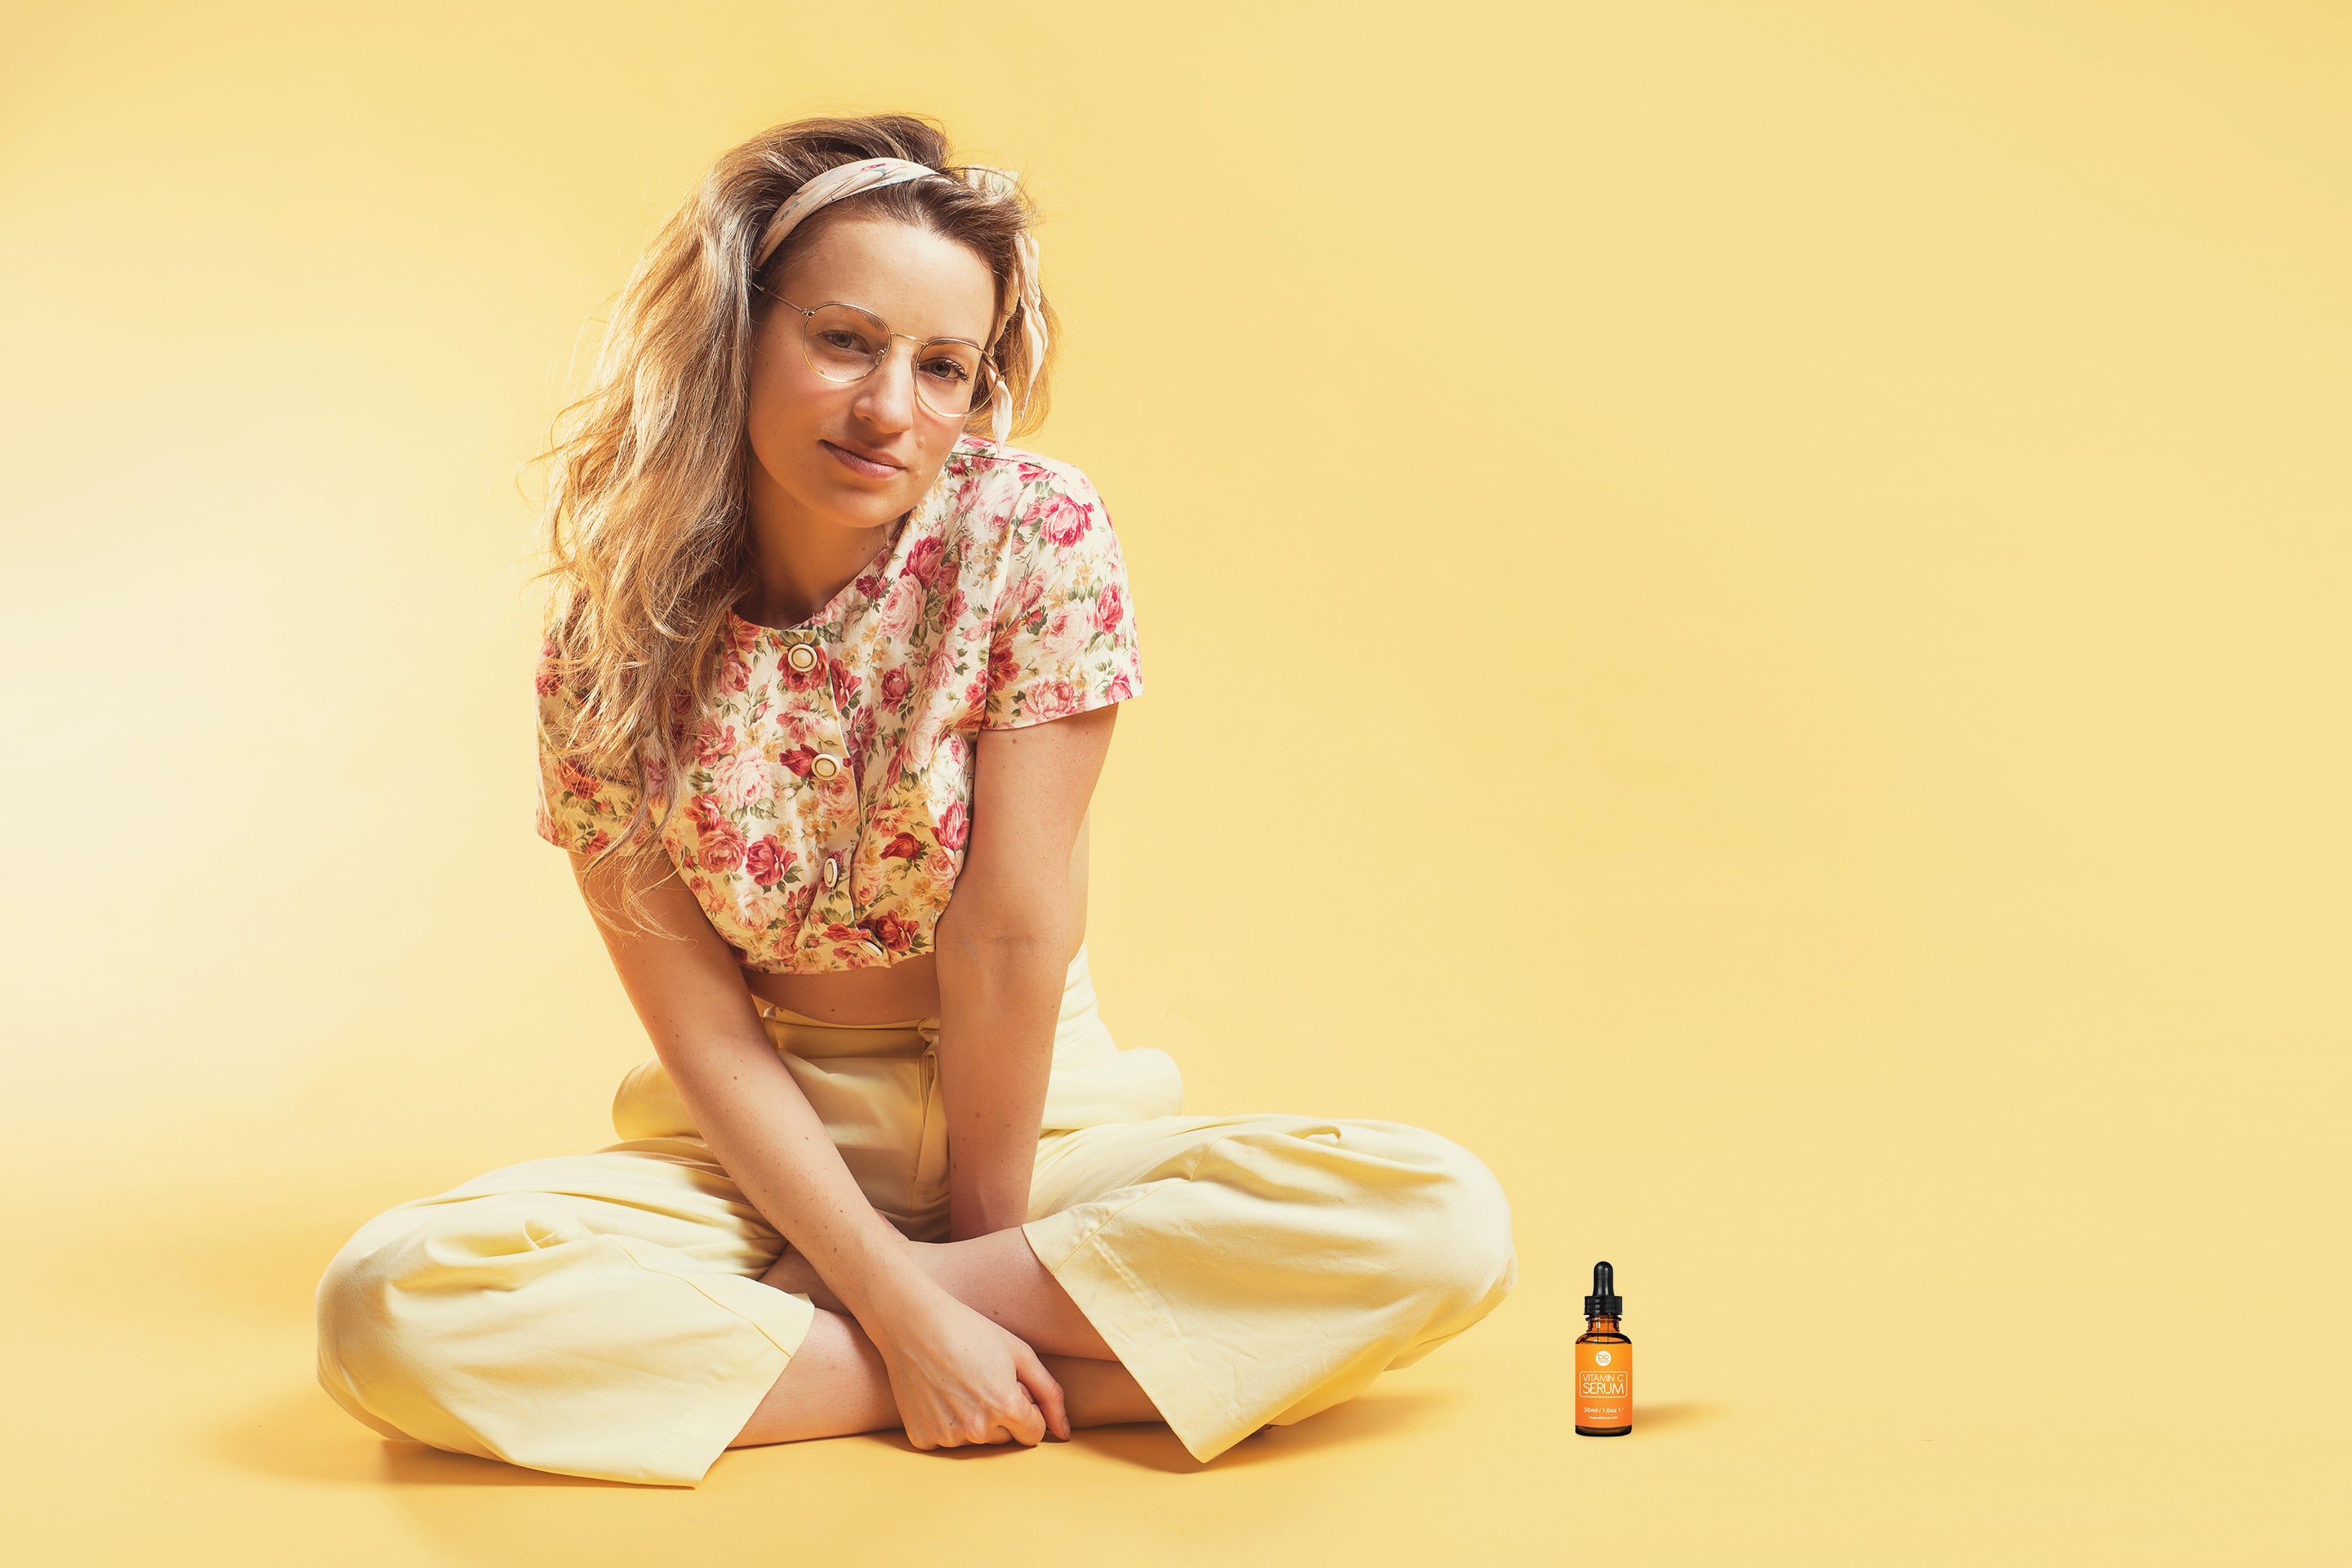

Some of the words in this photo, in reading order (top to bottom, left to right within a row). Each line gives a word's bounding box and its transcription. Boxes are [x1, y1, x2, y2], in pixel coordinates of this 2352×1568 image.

[1582, 1374, 1615, 1382] VITAMIN
[1617, 1374, 1624, 1382] C
[1582, 1382, 1624, 1394] SERUM
